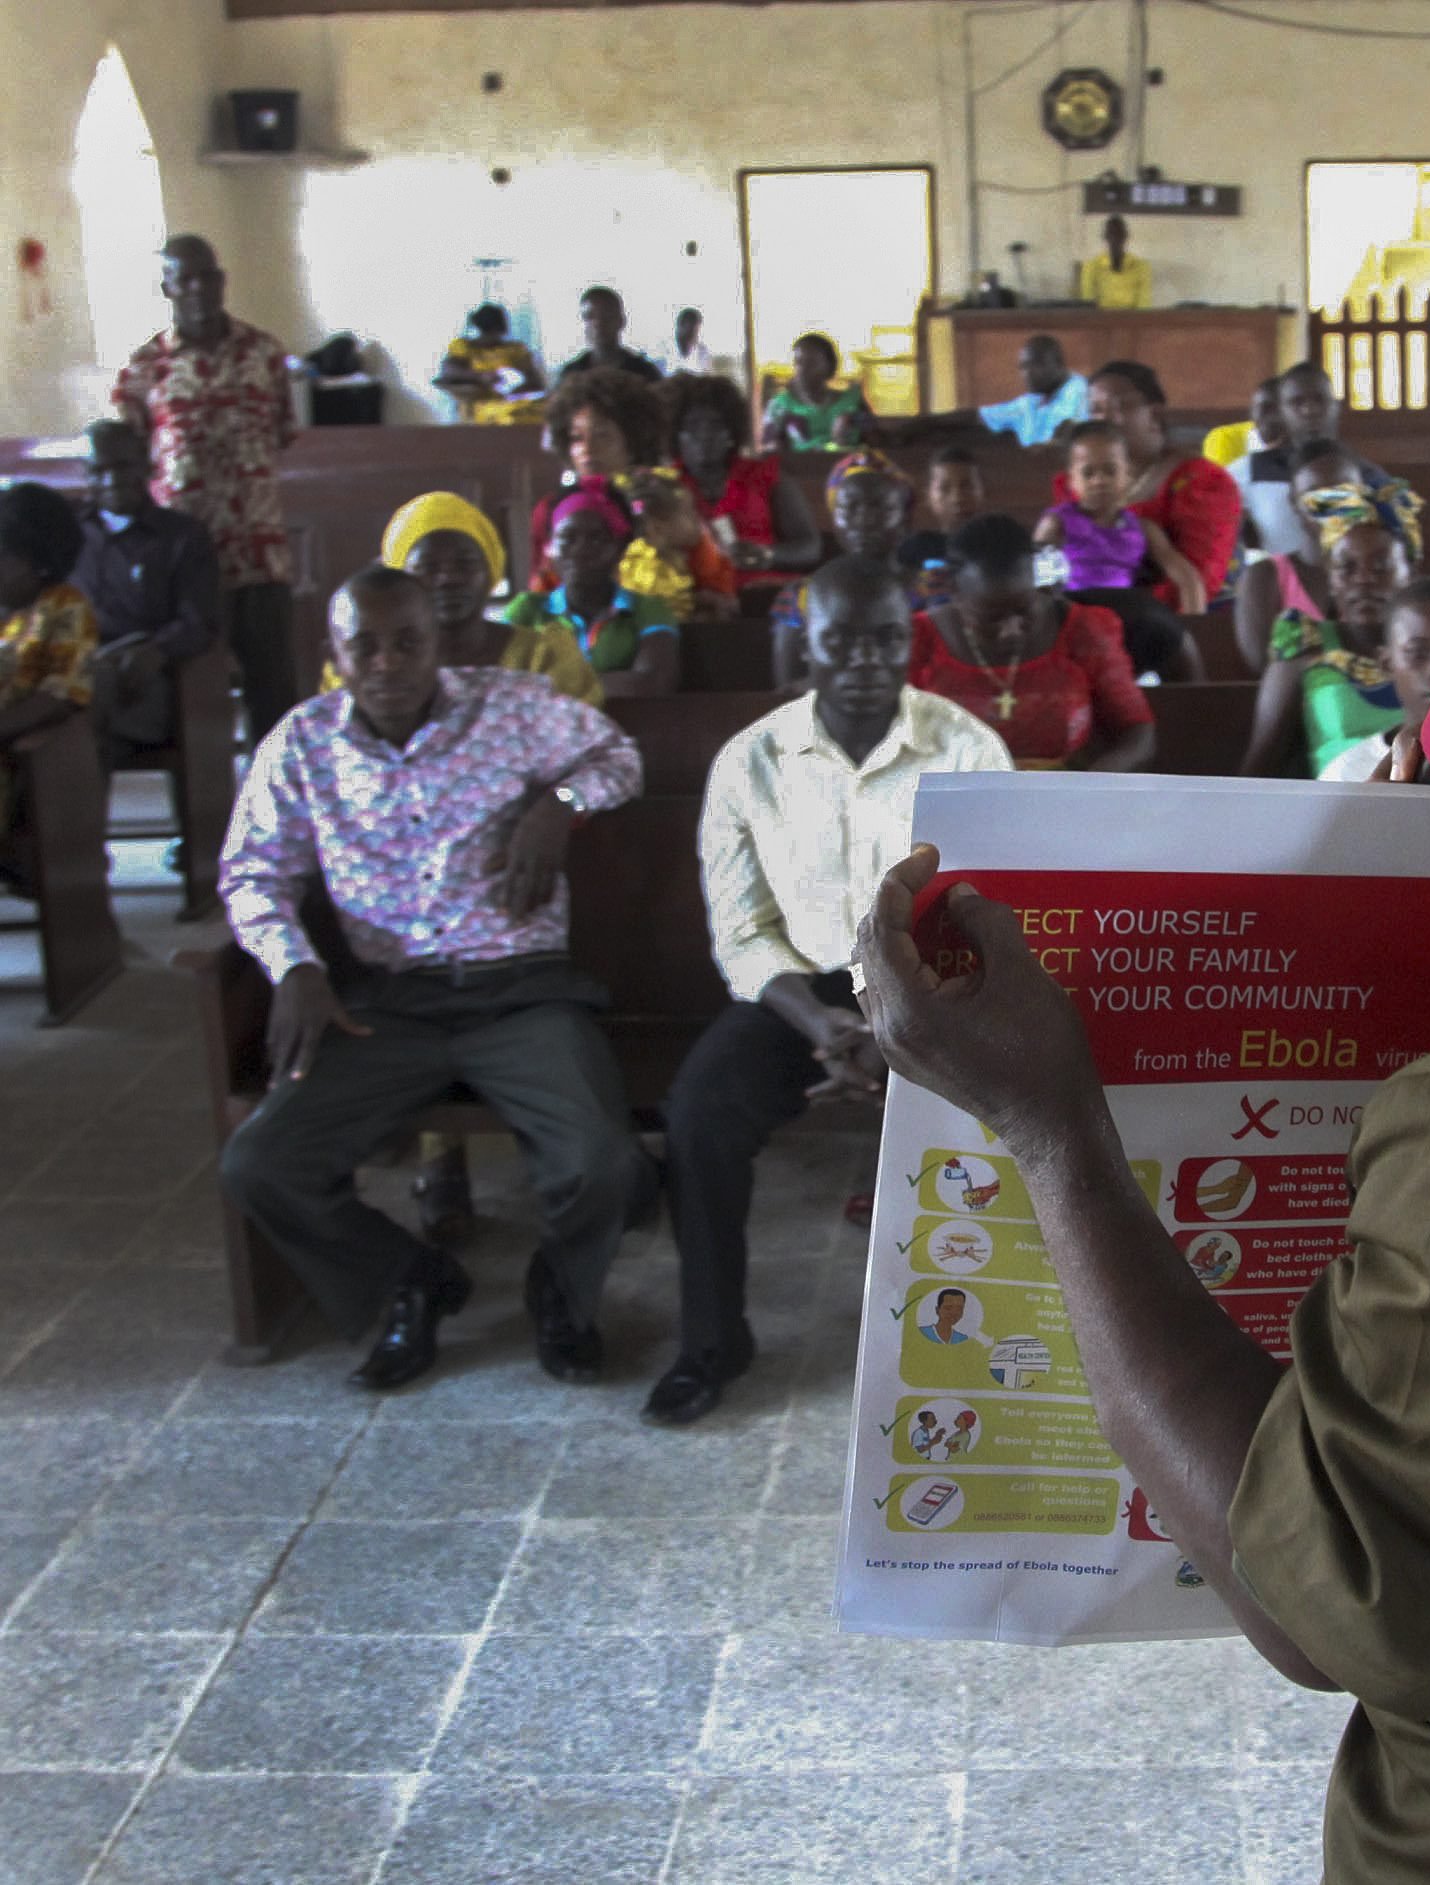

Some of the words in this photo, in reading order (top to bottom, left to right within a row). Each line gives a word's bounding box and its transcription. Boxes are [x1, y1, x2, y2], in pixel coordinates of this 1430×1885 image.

[1094, 909, 1257, 936] YOURSELF
[1091, 947, 1176, 974] YOUR
[1188, 948, 1297, 974] FAMILY
[1089, 986, 1173, 1012] YOUR
[1185, 985, 1375, 1010] COMMUNITY
[1134, 1049, 1187, 1071] from
[1196, 1049, 1232, 1069] the
[1239, 1028, 1358, 1068] Ebola
[1289, 1106, 1324, 1126] DO
[1281, 1166, 1298, 1176] Do
[1301, 1166, 1323, 1175] not
[1268, 1182, 1297, 1193] with
[1301, 1182, 1334, 1194] signs
[1288, 1198, 1318, 1208] have
[1322, 1197, 1350, 1207] died
[1252, 1239, 1270, 1249] Do
[1273, 1239, 1295, 1249] not
[1298, 1237, 1334, 1248] touch
[1266, 1254, 1291, 1263] bed
[1294, 1252, 1333, 1262] cloths
[1246, 1270, 1273, 1279] who
[1277, 1269, 1307, 1279] have
[865, 1559, 897, 1569] Let's
[901, 1560, 930, 1571] stop
[934, 1561, 955, 1570] the
[959, 1561, 1002, 1571] spread
[1007, 1561, 1020, 1570] of
[1023, 1561, 1059, 1571] Ebola
[1063, 1563, 1119, 1576] together
